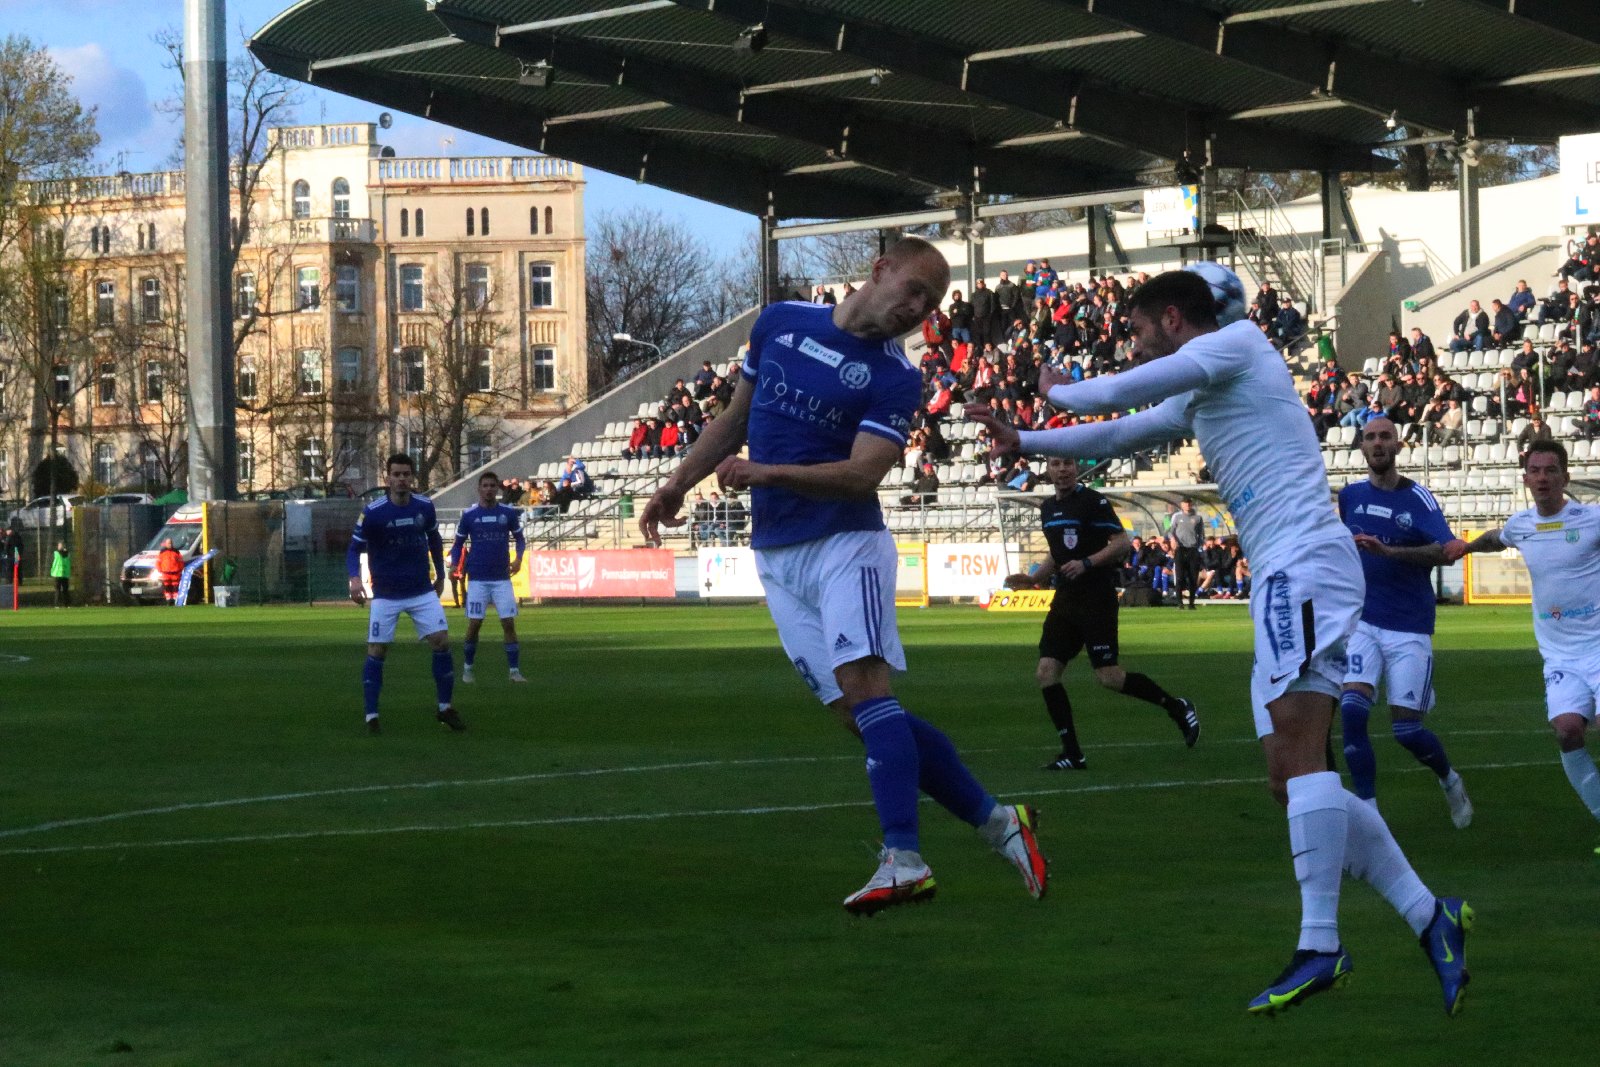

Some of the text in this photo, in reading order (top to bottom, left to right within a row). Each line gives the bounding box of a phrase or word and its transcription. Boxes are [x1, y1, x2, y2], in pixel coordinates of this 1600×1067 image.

[803, 342, 838, 362] FORTUNA
[761, 374, 843, 423] VOTUM
[961, 555, 999, 576] RSW
[990, 594, 1051, 608] FORTUN
[1273, 568, 1295, 652] DACHLAND
[372, 621, 379, 637] 8
[794, 656, 819, 692] 8
